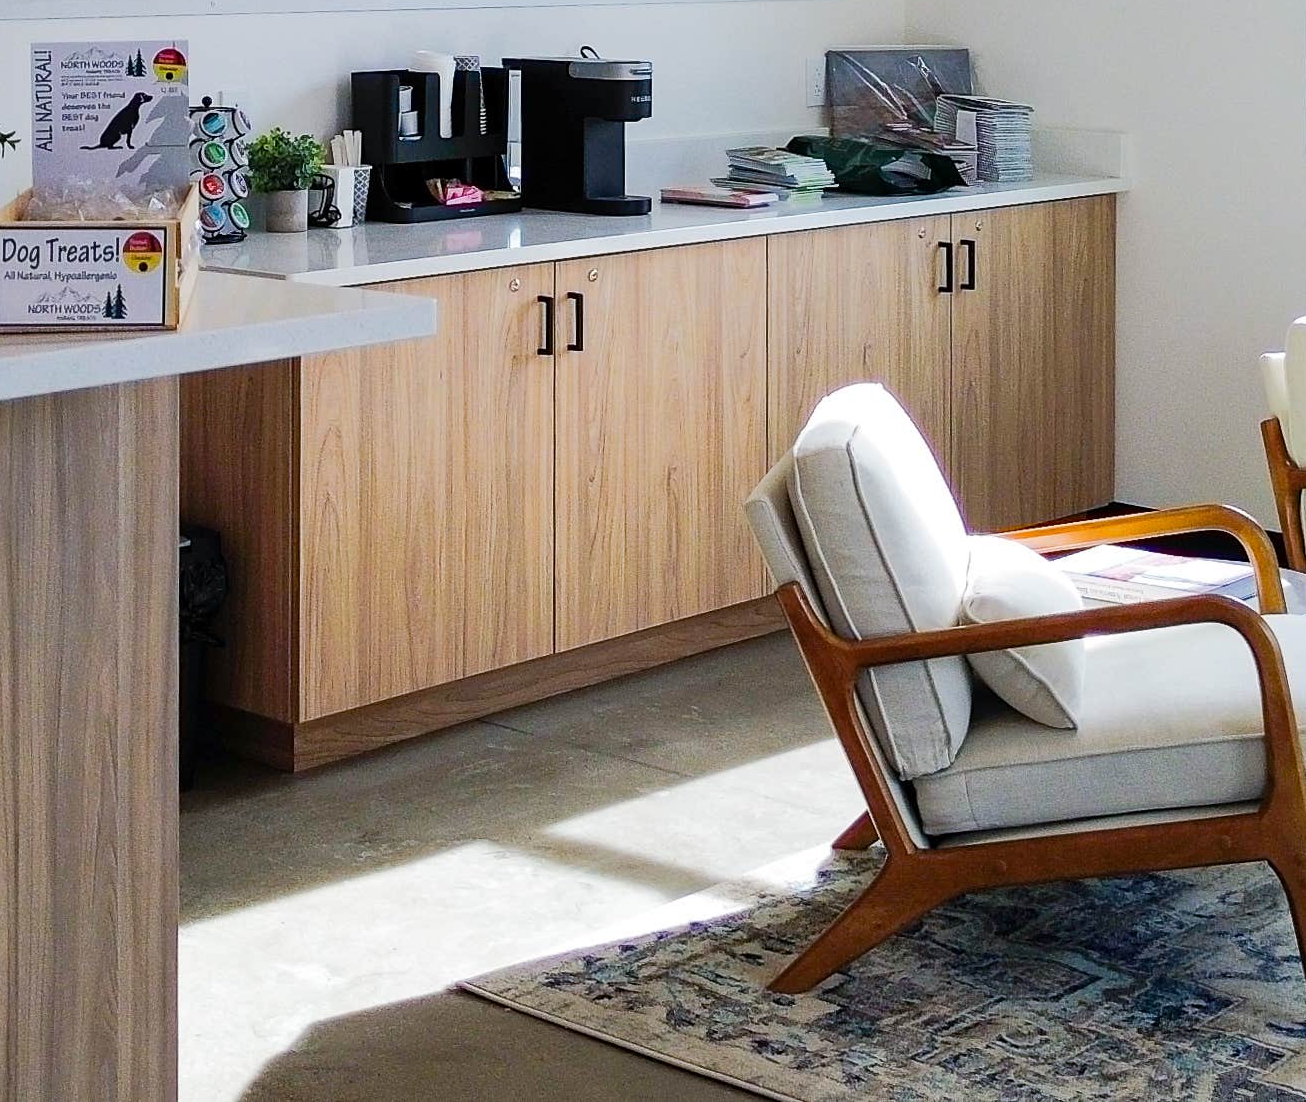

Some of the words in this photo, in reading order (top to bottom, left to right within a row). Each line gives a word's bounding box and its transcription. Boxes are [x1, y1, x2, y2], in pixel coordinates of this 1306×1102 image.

[61, 60, 90, 70] NORTH
[91, 60, 124, 69] WOODS
[34, 50, 53, 122] NATURAL!
[80, 91, 102, 99] BEST
[103, 91, 126, 99] friend
[85, 114, 99, 122] dog
[34, 125, 53, 152] ALL
[2, 238, 40, 270] Dog
[46, 237, 120, 263] Treats!
[4, 271, 15, 280] All
[54, 271, 117, 283] Hypoallergenic
[28, 304, 62, 314] NORTH
[64, 304, 102, 314] WOODS
